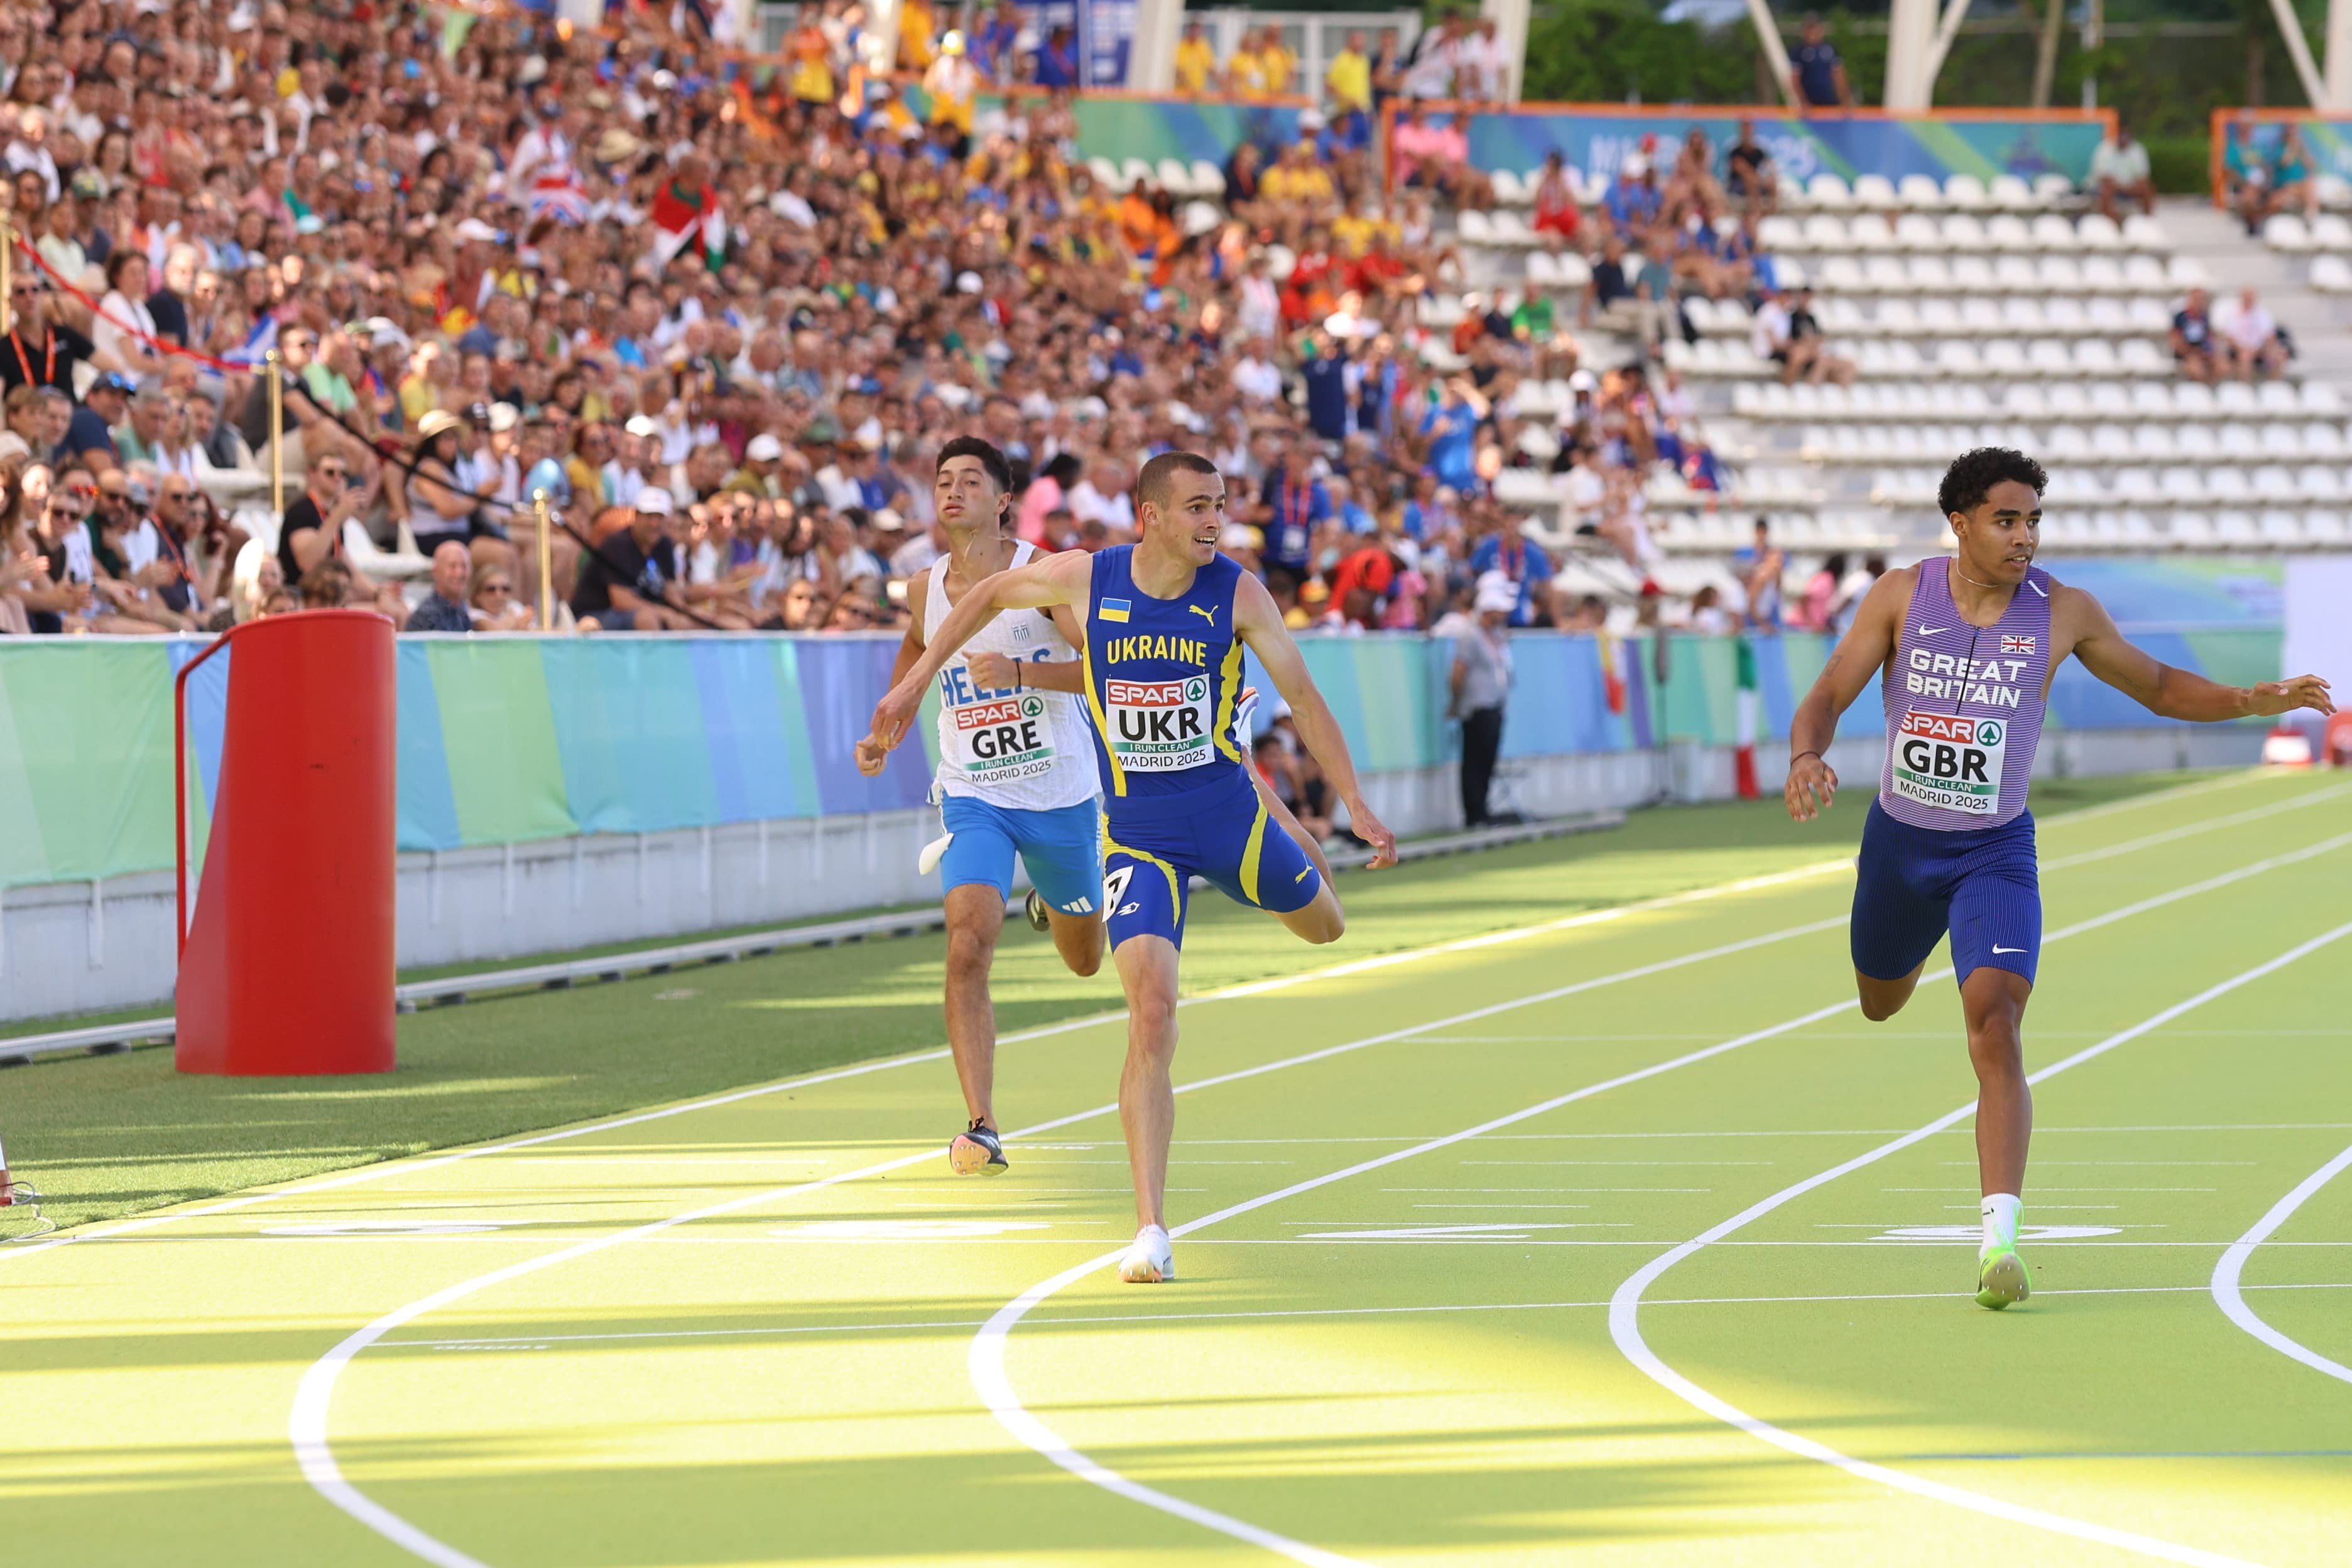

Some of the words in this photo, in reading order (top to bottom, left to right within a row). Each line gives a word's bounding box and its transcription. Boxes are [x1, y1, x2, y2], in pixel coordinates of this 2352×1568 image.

[1107, 635, 1207, 667] UKRAINE
[1910, 648, 2027, 682] GREAT
[1109, 685, 1182, 704] SPAR
[1907, 671, 2021, 709] BRITAIN
[957, 702, 1020, 727] SPAR
[1119, 707, 1203, 742] UKR
[1902, 713, 1973, 741] SPAR
[972, 721, 1042, 759] GRE
[1135, 743, 1156, 753] RUN
[972, 768, 1020, 783] MADRID
[1022, 760, 1051, 774] 2025
[985, 759, 1004, 769] RUN
[1118, 756, 1173, 767] MADRID
[1177, 749, 1206, 766] 2025
[1903, 739, 1989, 783] GBR
[1915, 775, 1936, 787] RUN
[1900, 781, 1951, 805] MADRID
[1955, 795, 1988, 810] 2025
[1108, 876, 1122, 910] 7
